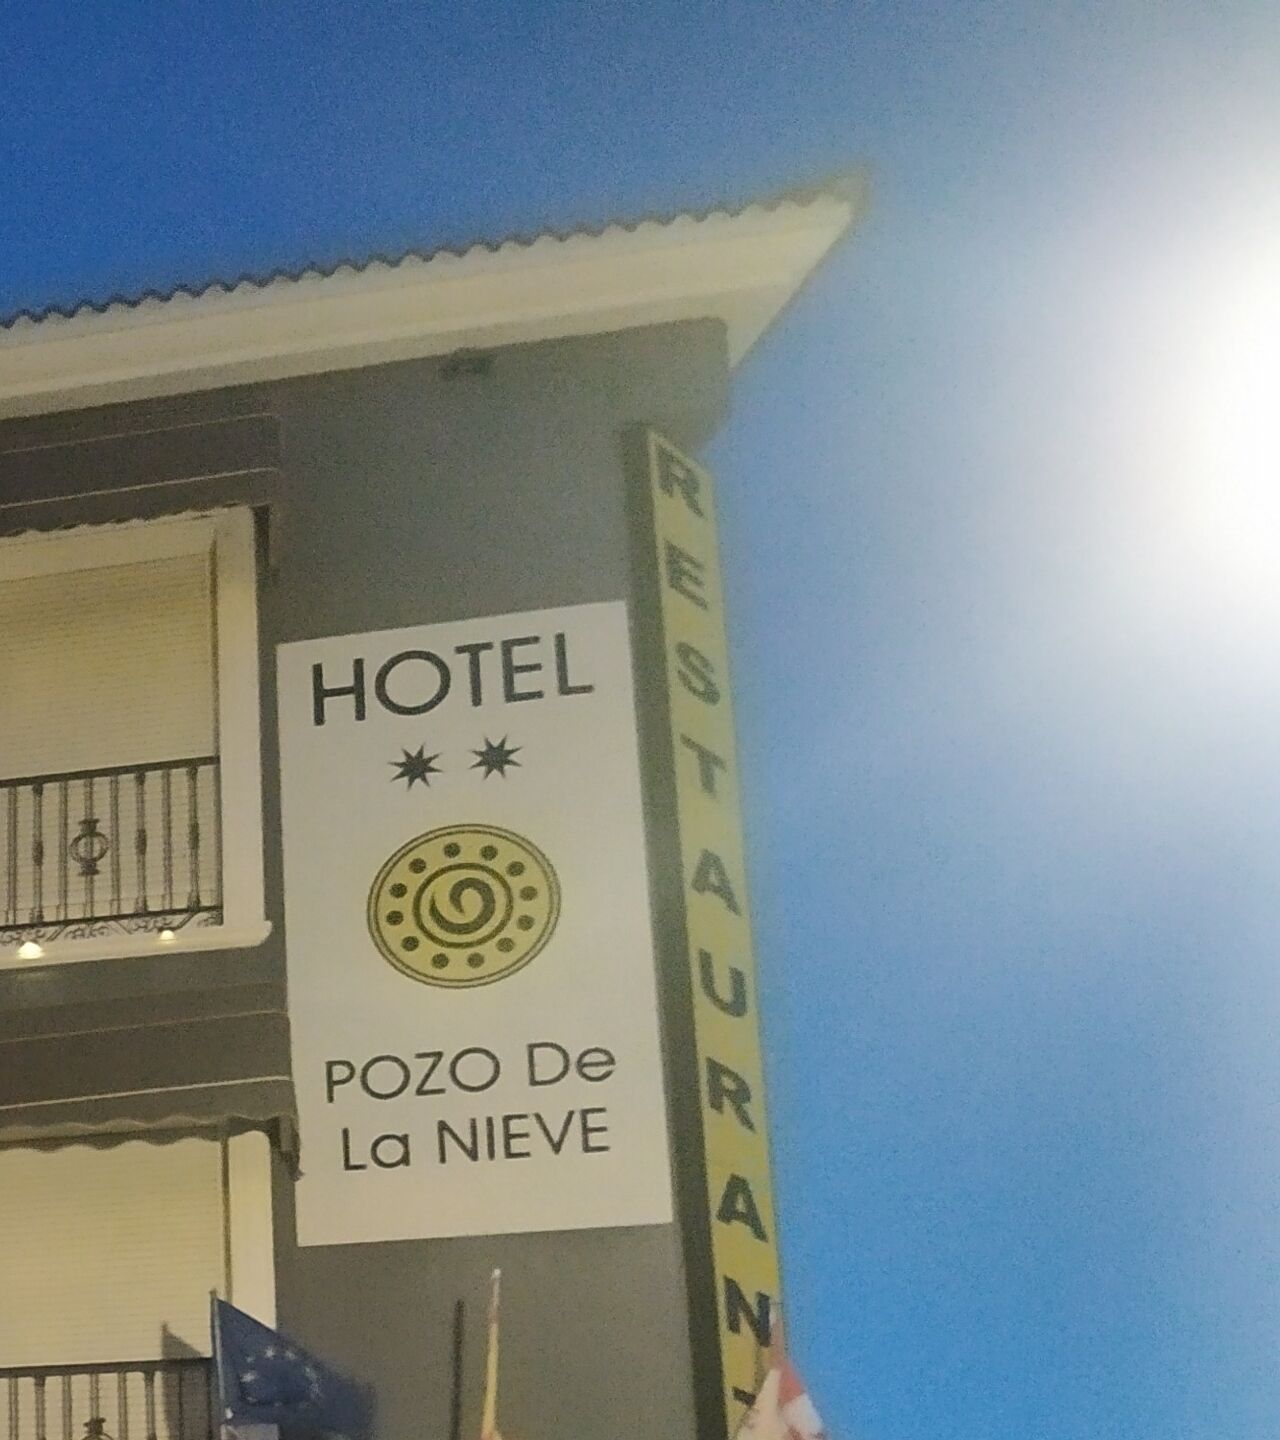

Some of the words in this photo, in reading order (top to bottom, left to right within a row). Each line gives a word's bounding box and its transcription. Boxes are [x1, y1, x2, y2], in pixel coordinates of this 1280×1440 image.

[312, 632, 595, 727] HOTEL
[326, 1046, 502, 1104] POZO
[527, 1041, 617, 1087] De
[341, 1127, 412, 1172] La
[438, 1106, 611, 1165] NIEVE
